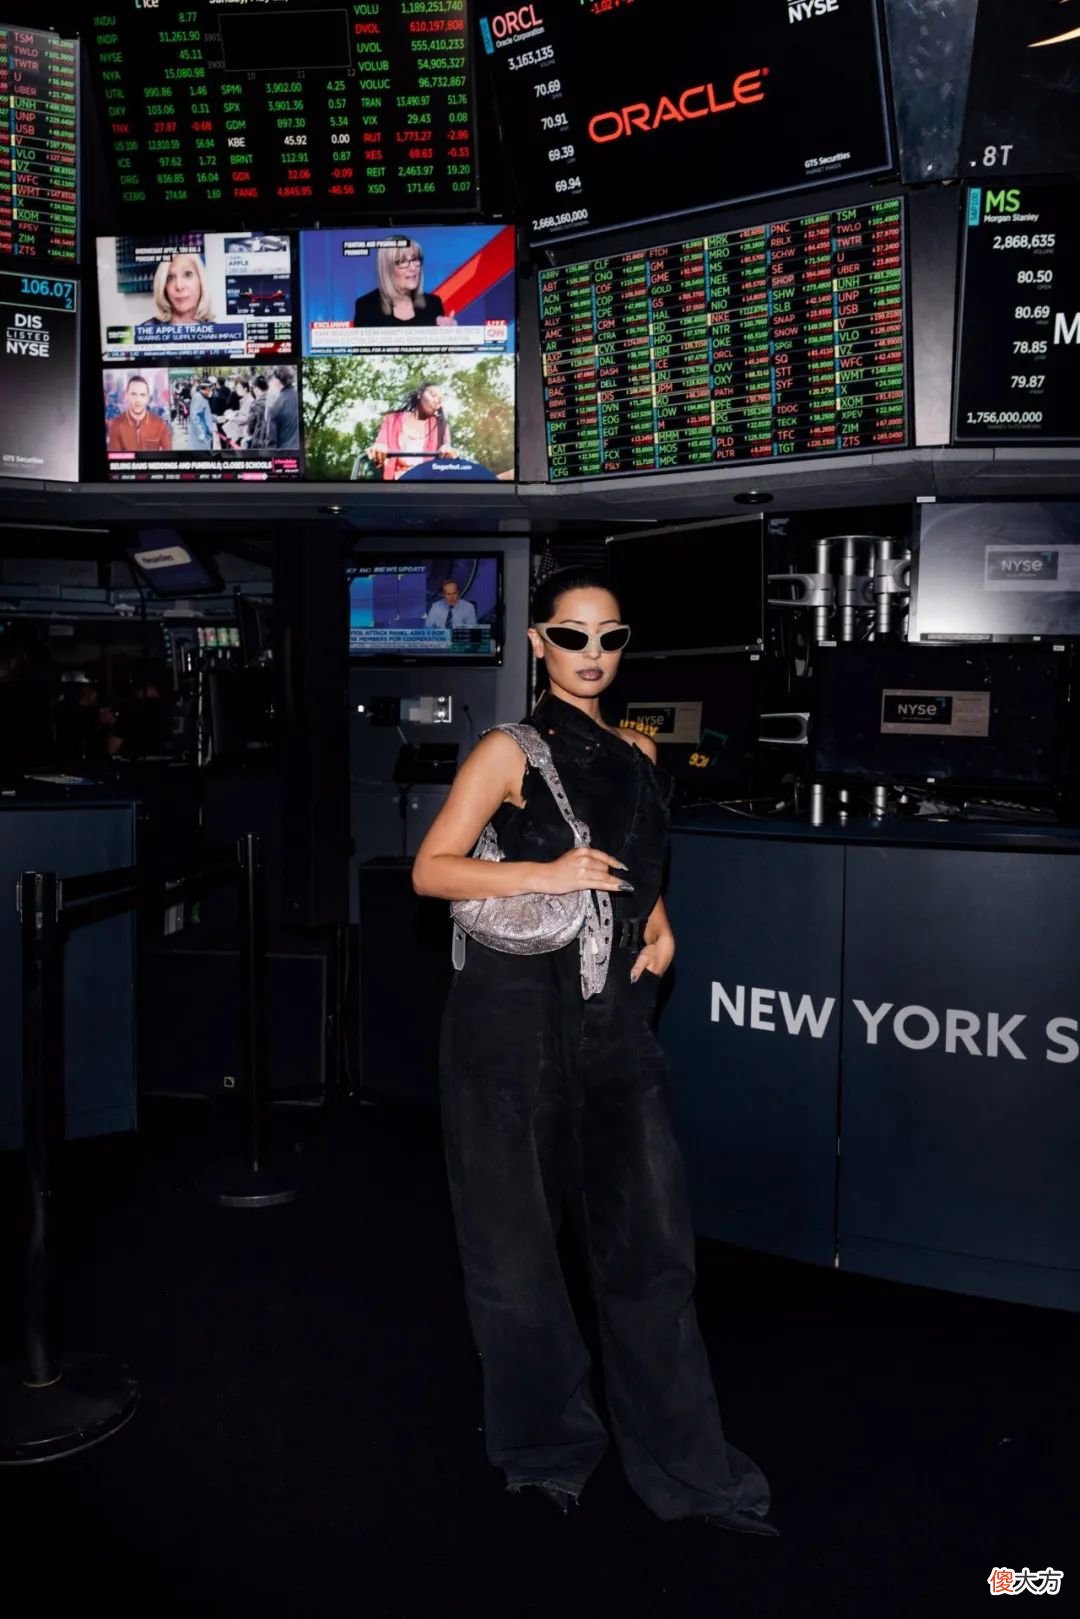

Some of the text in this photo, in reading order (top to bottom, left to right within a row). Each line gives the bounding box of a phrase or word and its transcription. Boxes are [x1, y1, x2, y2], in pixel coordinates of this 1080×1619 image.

[354, 1, 462, 15] VOLU 1,189,251,740
[788, 0, 839, 23] NYSE
[492, 4, 543, 38] ORCL
[356, 24, 379, 34] DVOL
[14, 32, 33, 44] TSM
[496, 27, 544, 48] Oracle Corporation
[357, 40, 464, 52] UVOL 555,410,233
[508, 45, 554, 70] 3,163,135
[358, 58, 465, 71] VOLUB 54,905,327
[327, 81, 346, 90] 4.25
[360, 76, 466, 89] VOLUC 96,732,867
[15, 86, 36, 96] UBER
[534, 80, 561, 97] 70.69
[589, 70, 764, 143] ORACLE
[16, 112, 36, 122] UNP
[330, 117, 348, 126] 5.34
[363, 114, 431, 125] VIX 29.43
[541, 112, 568, 130] 70.91
[16, 124, 35, 135] USB
[228, 138, 245, 146] KBE
[285, 134, 349, 145] 45.92 0.00
[17, 149, 36, 160] VLO
[333, 151, 350, 161] 0.87
[548, 145, 574, 161] 69.39
[804, 151, 850, 168] GTS Securities
[367, 165, 470, 176] REIT 19.20
[17, 175, 38, 185] WFC
[555, 177, 581, 192] 69.94
[986, 190, 1020, 213] MS
[532, 209, 588, 231] 2,668,160,000
[837, 210, 856, 220] TSM
[984, 213, 1039, 224] Morgan Stanley
[771, 224, 790, 233] PNC
[837, 223, 861, 234] TWLO
[19, 234, 35, 244] ZIM
[837, 236, 862, 246] TWTR
[993, 235, 1055, 250] 2,868,635
[19, 245, 36, 255] ZTS
[710, 249, 729, 258] MRO
[710, 262, 722, 272] MS
[838, 264, 860, 274] UBER
[595, 272, 612, 282] CNQ
[651, 272, 669, 282] GME
[711, 275, 728, 284] NEE
[772, 276, 794, 286] SHOP
[1017, 271, 1053, 283] 80.50
[21, 278, 72, 298] 106.07
[711, 288, 730, 297] NEM
[773, 289, 795, 299] SHW
[839, 291, 859, 301] UNP
[65, 298, 72, 309] 2
[597, 297, 613, 306] COP
[711, 301, 728, 310] NIO
[544, 306, 561, 315] ADM
[773, 302, 791, 312] SLB
[839, 304, 858, 315] USB
[653, 311, 669, 320] HAL
[1015, 306, 1050, 319] 80.69
[15, 314, 42, 329] DIS
[598, 320, 615, 329] CRM
[7, 331, 49, 341] LISTED
[545, 331, 562, 339] AMC
[774, 328, 798, 338] SNOW
[840, 331, 859, 341] VLO
[713, 338, 731, 348] OKE
[1013, 342, 1047, 354] 78.85
[6, 342, 49, 357] NYSE
[600, 356, 615, 365] DAL
[841, 358, 862, 368] WFC
[714, 363, 732, 373] OVV
[776, 367, 792, 376] STT
[714, 376, 732, 385] OXY
[776, 380, 793, 390] SYF
[1011, 376, 1044, 388] 79.87
[602, 403, 619, 412] DVN
[658, 408, 677, 417] LOW
[603, 415, 619, 424] EOG
[967, 412, 1042, 424] 1,756,000,000
[843, 423, 858, 432] ZIM
[778, 431, 794, 440] TFC
[717, 438, 733, 447] PLD
[843, 436, 860, 446] ZTS
[660, 444, 677, 453] MOS
[778, 443, 794, 452] TGT
[605, 450, 620, 459] FCX
[246, 461, 272, 469] SCHOOLS
[660, 457, 677, 465] MPC
[553, 468, 568, 477] CFG
[710, 981, 1079, 1064] NEW YORK S
